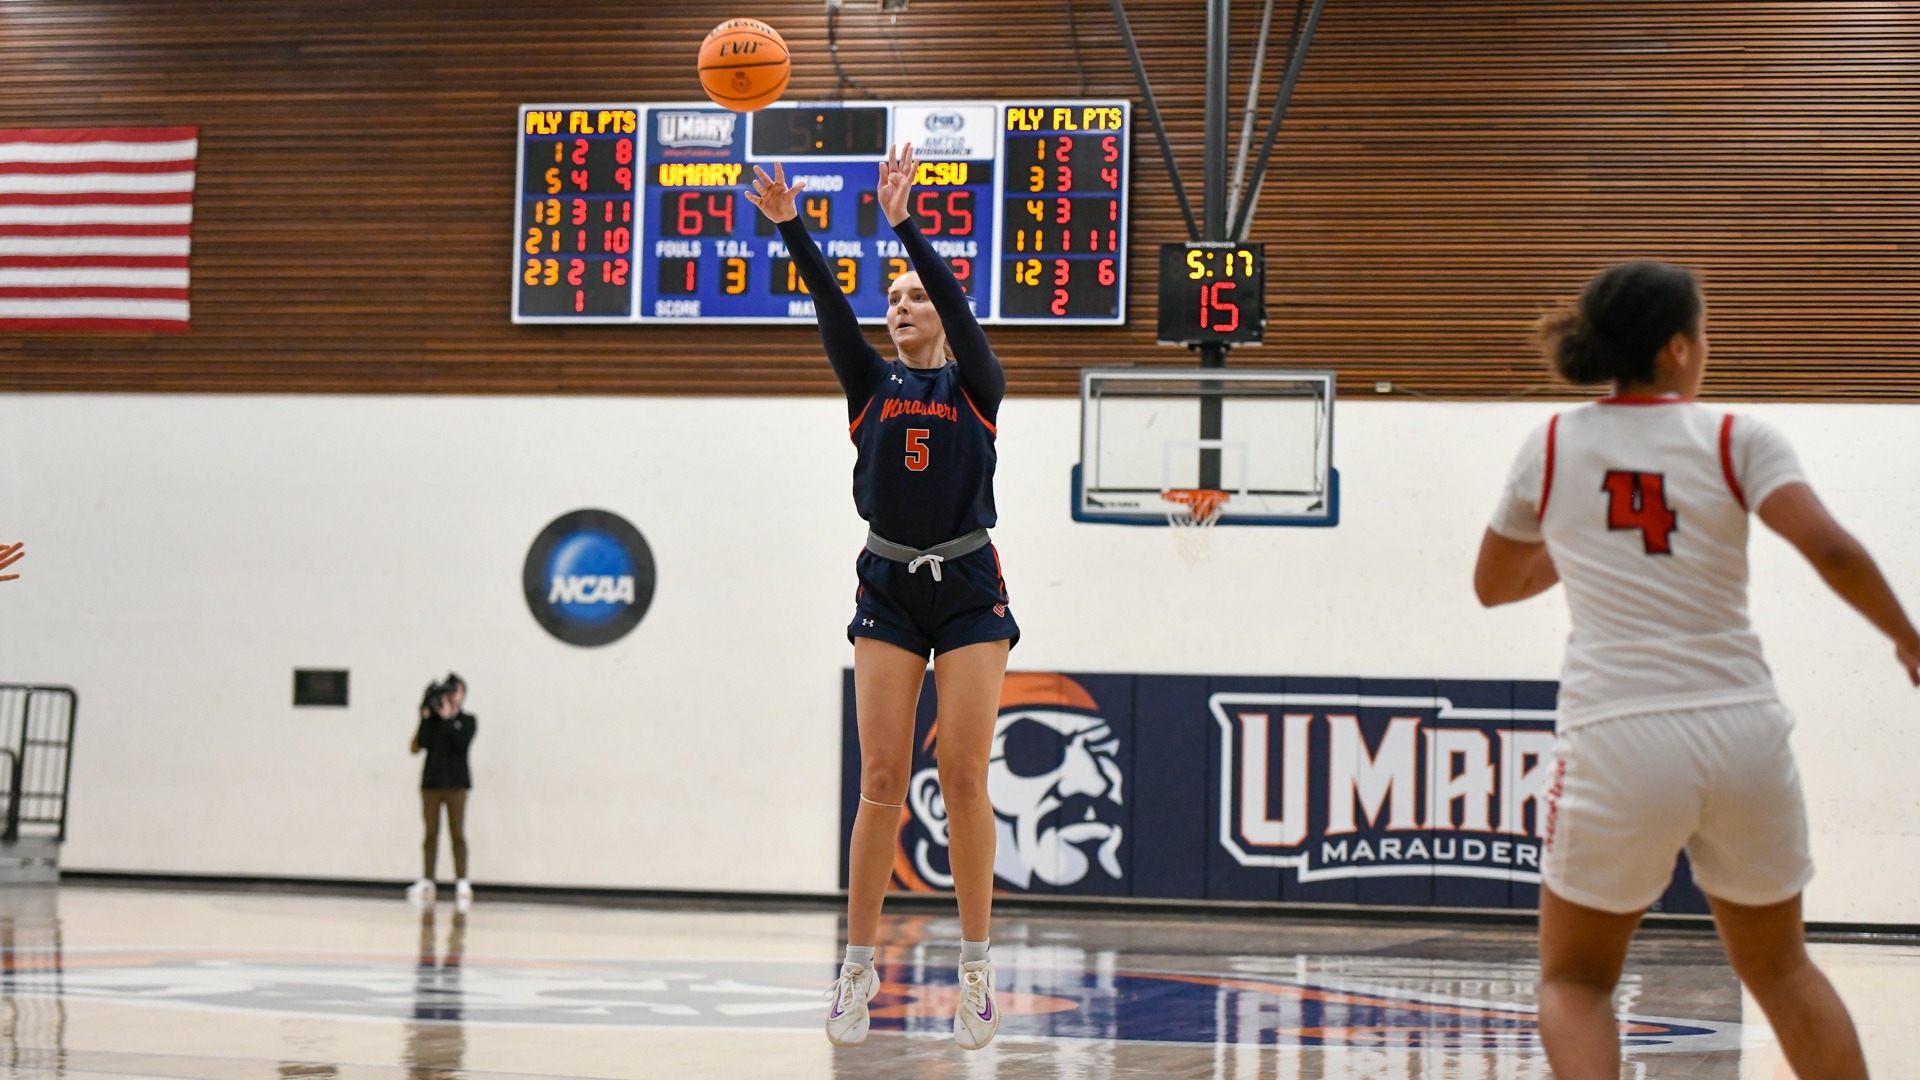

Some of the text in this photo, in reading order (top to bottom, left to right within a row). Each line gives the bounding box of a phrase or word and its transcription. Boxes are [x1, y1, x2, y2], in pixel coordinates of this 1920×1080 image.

[525, 110, 637, 135] PLY FL PTS
[660, 114, 733, 142] UMARY
[1007, 107, 1122, 131] PLY FL PTS
[555, 138, 633, 165] 1 2 8
[1037, 135, 1119, 163] 1 2 5
[545, 167, 632, 195] 5 4 9
[658, 163, 743, 187] UMARY
[793, 176, 843, 192] PERIOD
[1029, 165, 1118, 193] 3 3 4
[535, 198, 631, 226] 13 3 11
[677, 192, 733, 236] 64
[807, 198, 828, 229] 4
[916, 191, 972, 236] 55
[1026, 197, 1118, 224] 4 3 1
[525, 226, 630, 255] 21 1 10
[656, 241, 701, 257] FOULS
[1016, 229, 1117, 252] 11 1 11
[523, 258, 629, 286] 23 2 12
[685, 260, 695, 291] 1
[726, 257, 746, 294] 3
[837, 258, 856, 294] 3
[1015, 258, 1116, 286] 12 3 6
[1186, 249, 1253, 280] 5:17
[656, 301, 700, 316] SCORE
[1051, 288, 1069, 316] 2
[1200, 281, 1239, 332] 15
[880, 398, 957, 422] Marauders
[905, 428, 930, 472] 5
[1601, 469, 1678, 556] 4
[549, 574, 635, 605] NCAA
[1238, 713, 1556, 847] UMAR
[1321, 837, 1541, 867] MARAUDER
